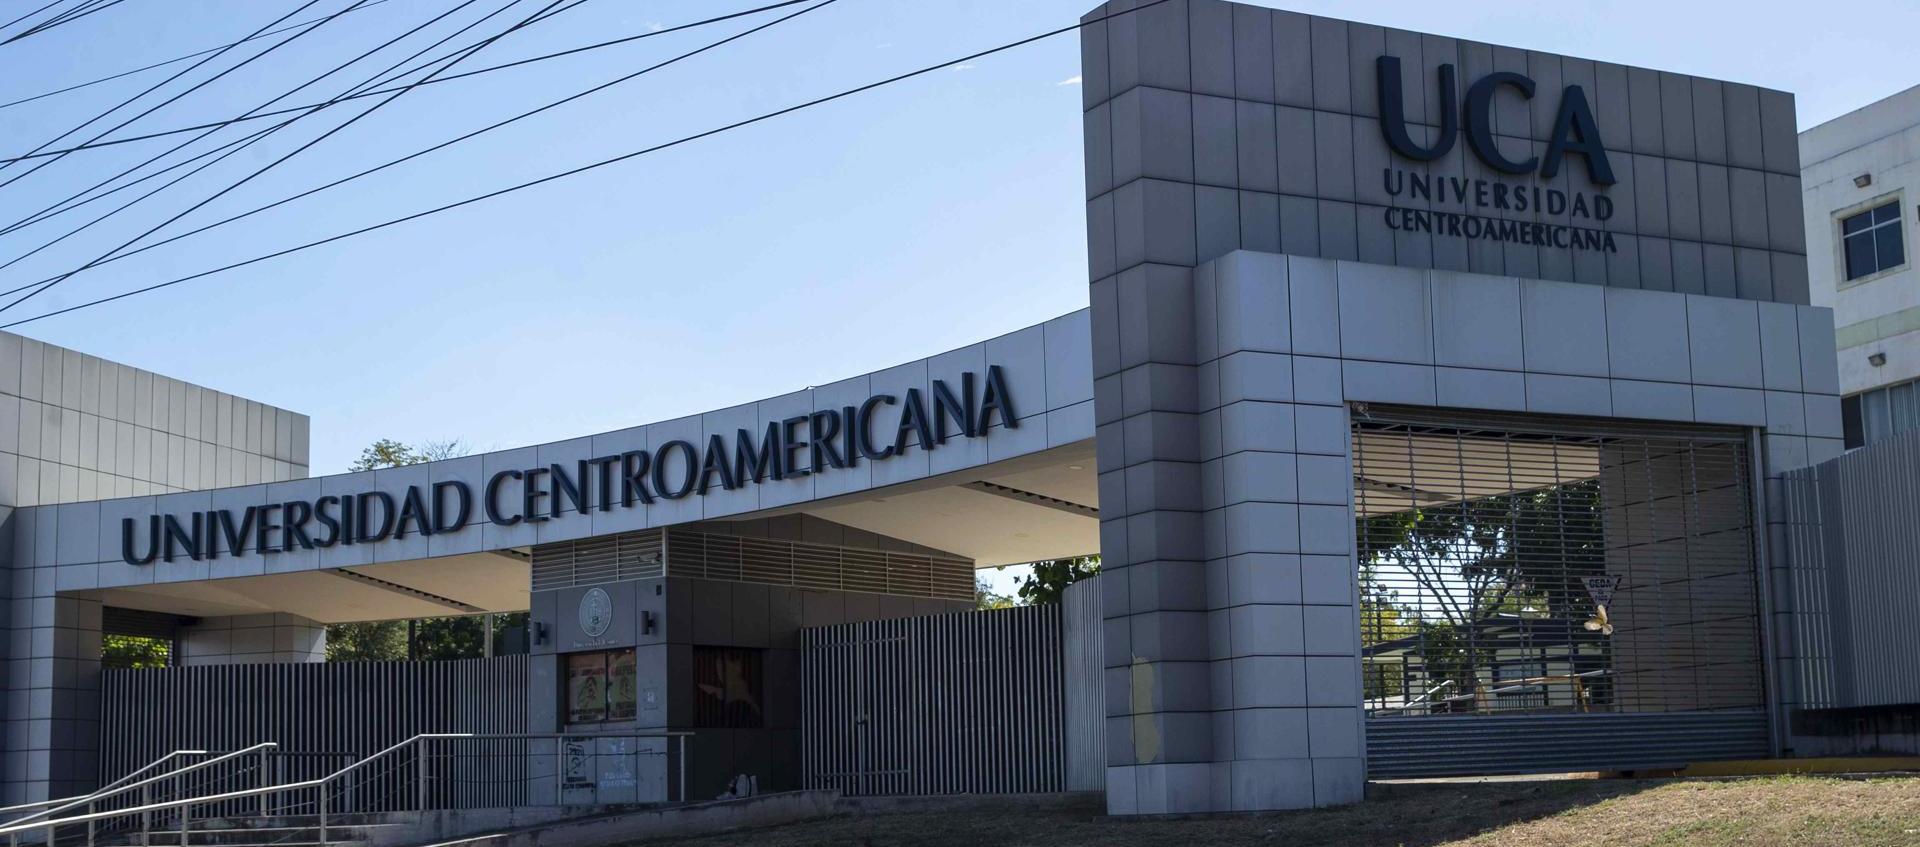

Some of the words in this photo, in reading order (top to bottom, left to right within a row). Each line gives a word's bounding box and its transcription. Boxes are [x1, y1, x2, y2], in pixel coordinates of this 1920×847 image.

[1377, 55, 1616, 185] UCA
[1384, 168, 1614, 221] UNIVERSIDAD
[1384, 206, 1617, 253] CENTROAMERICANA
[122, 480, 472, 566] UNIVERSIDAD
[484, 365, 1018, 526] CENTROAMERICANA
